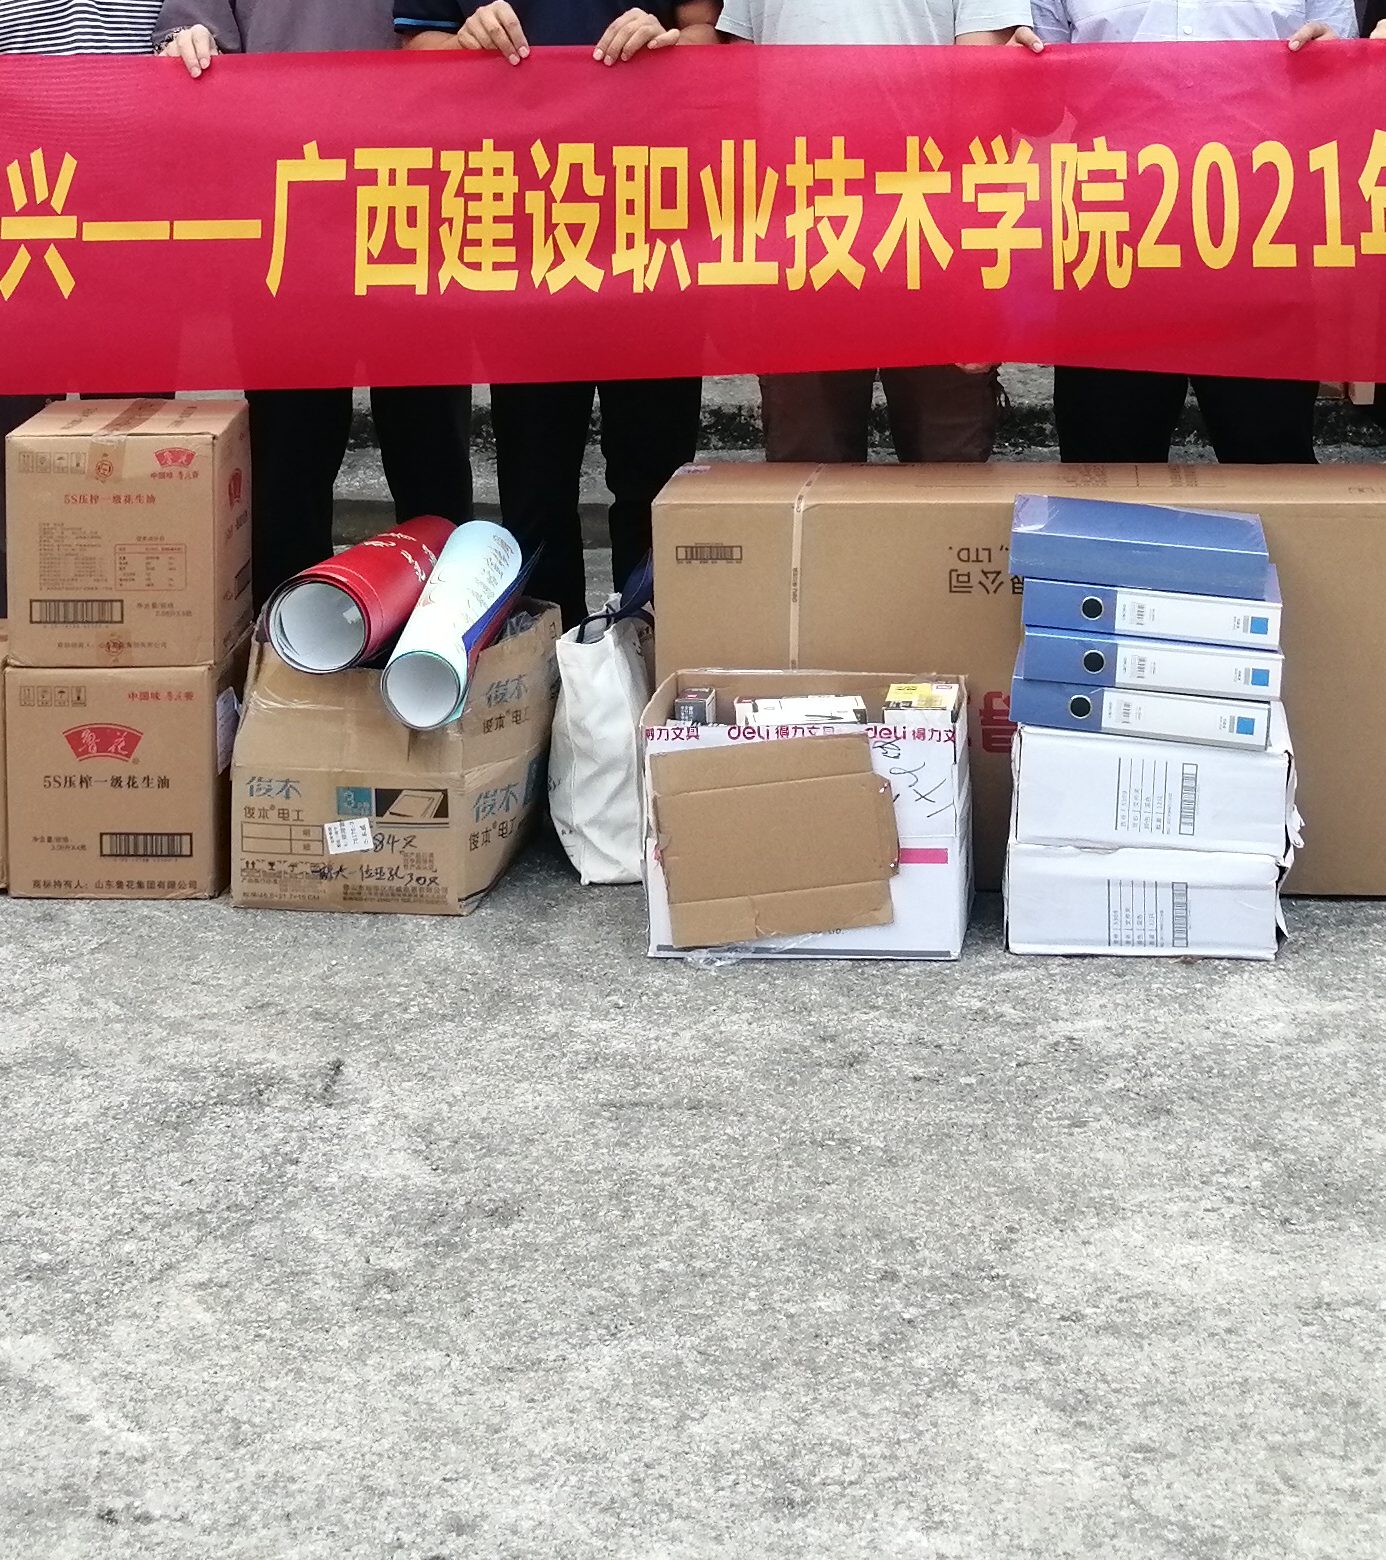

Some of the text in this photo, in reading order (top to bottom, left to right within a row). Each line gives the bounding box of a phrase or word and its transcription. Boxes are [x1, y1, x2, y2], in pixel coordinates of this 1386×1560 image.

[947, 545, 992, 563] LTD.
[78, 728, 128, 755] 鲁花
[727, 725, 771, 741] deli
[43, 774, 170, 790] 5S压榨一级花生油
